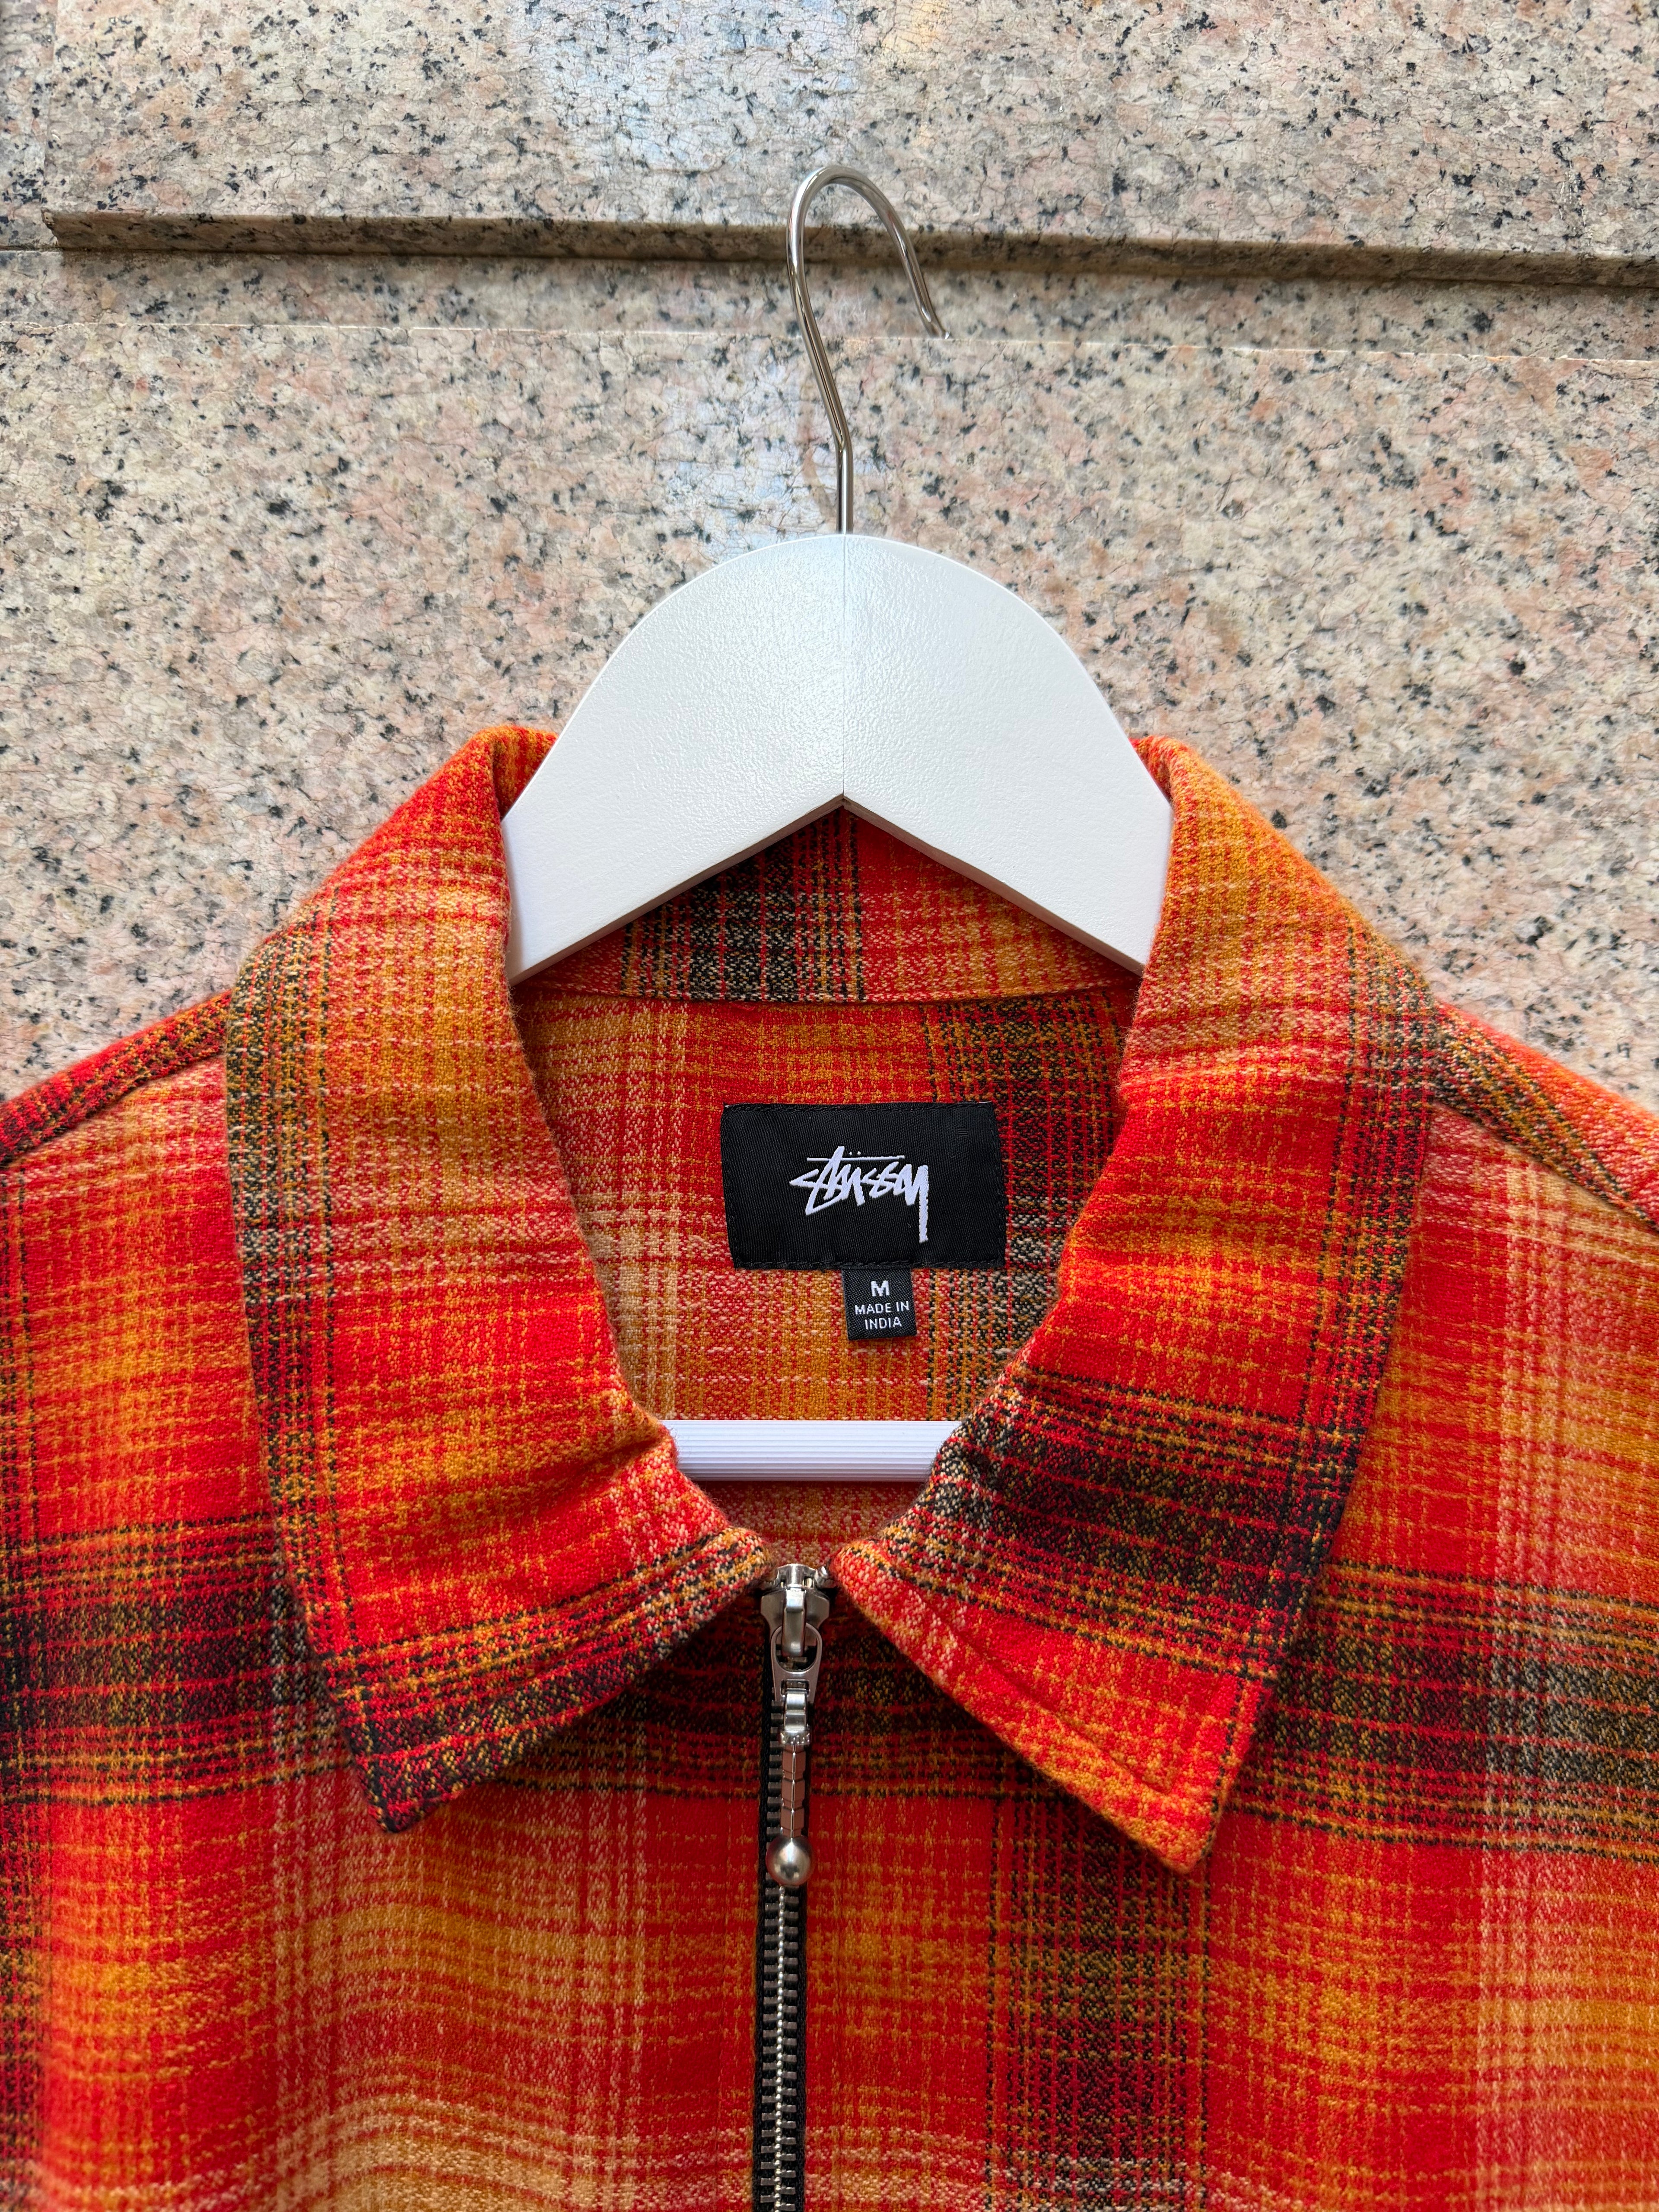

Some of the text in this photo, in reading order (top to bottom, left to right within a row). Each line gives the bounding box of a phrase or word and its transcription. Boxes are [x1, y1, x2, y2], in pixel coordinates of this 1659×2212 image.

[871, 1280, 890, 1297] M
[855, 1300, 910, 1315] MADE IN
[864, 1316, 902, 1330] INDIA
